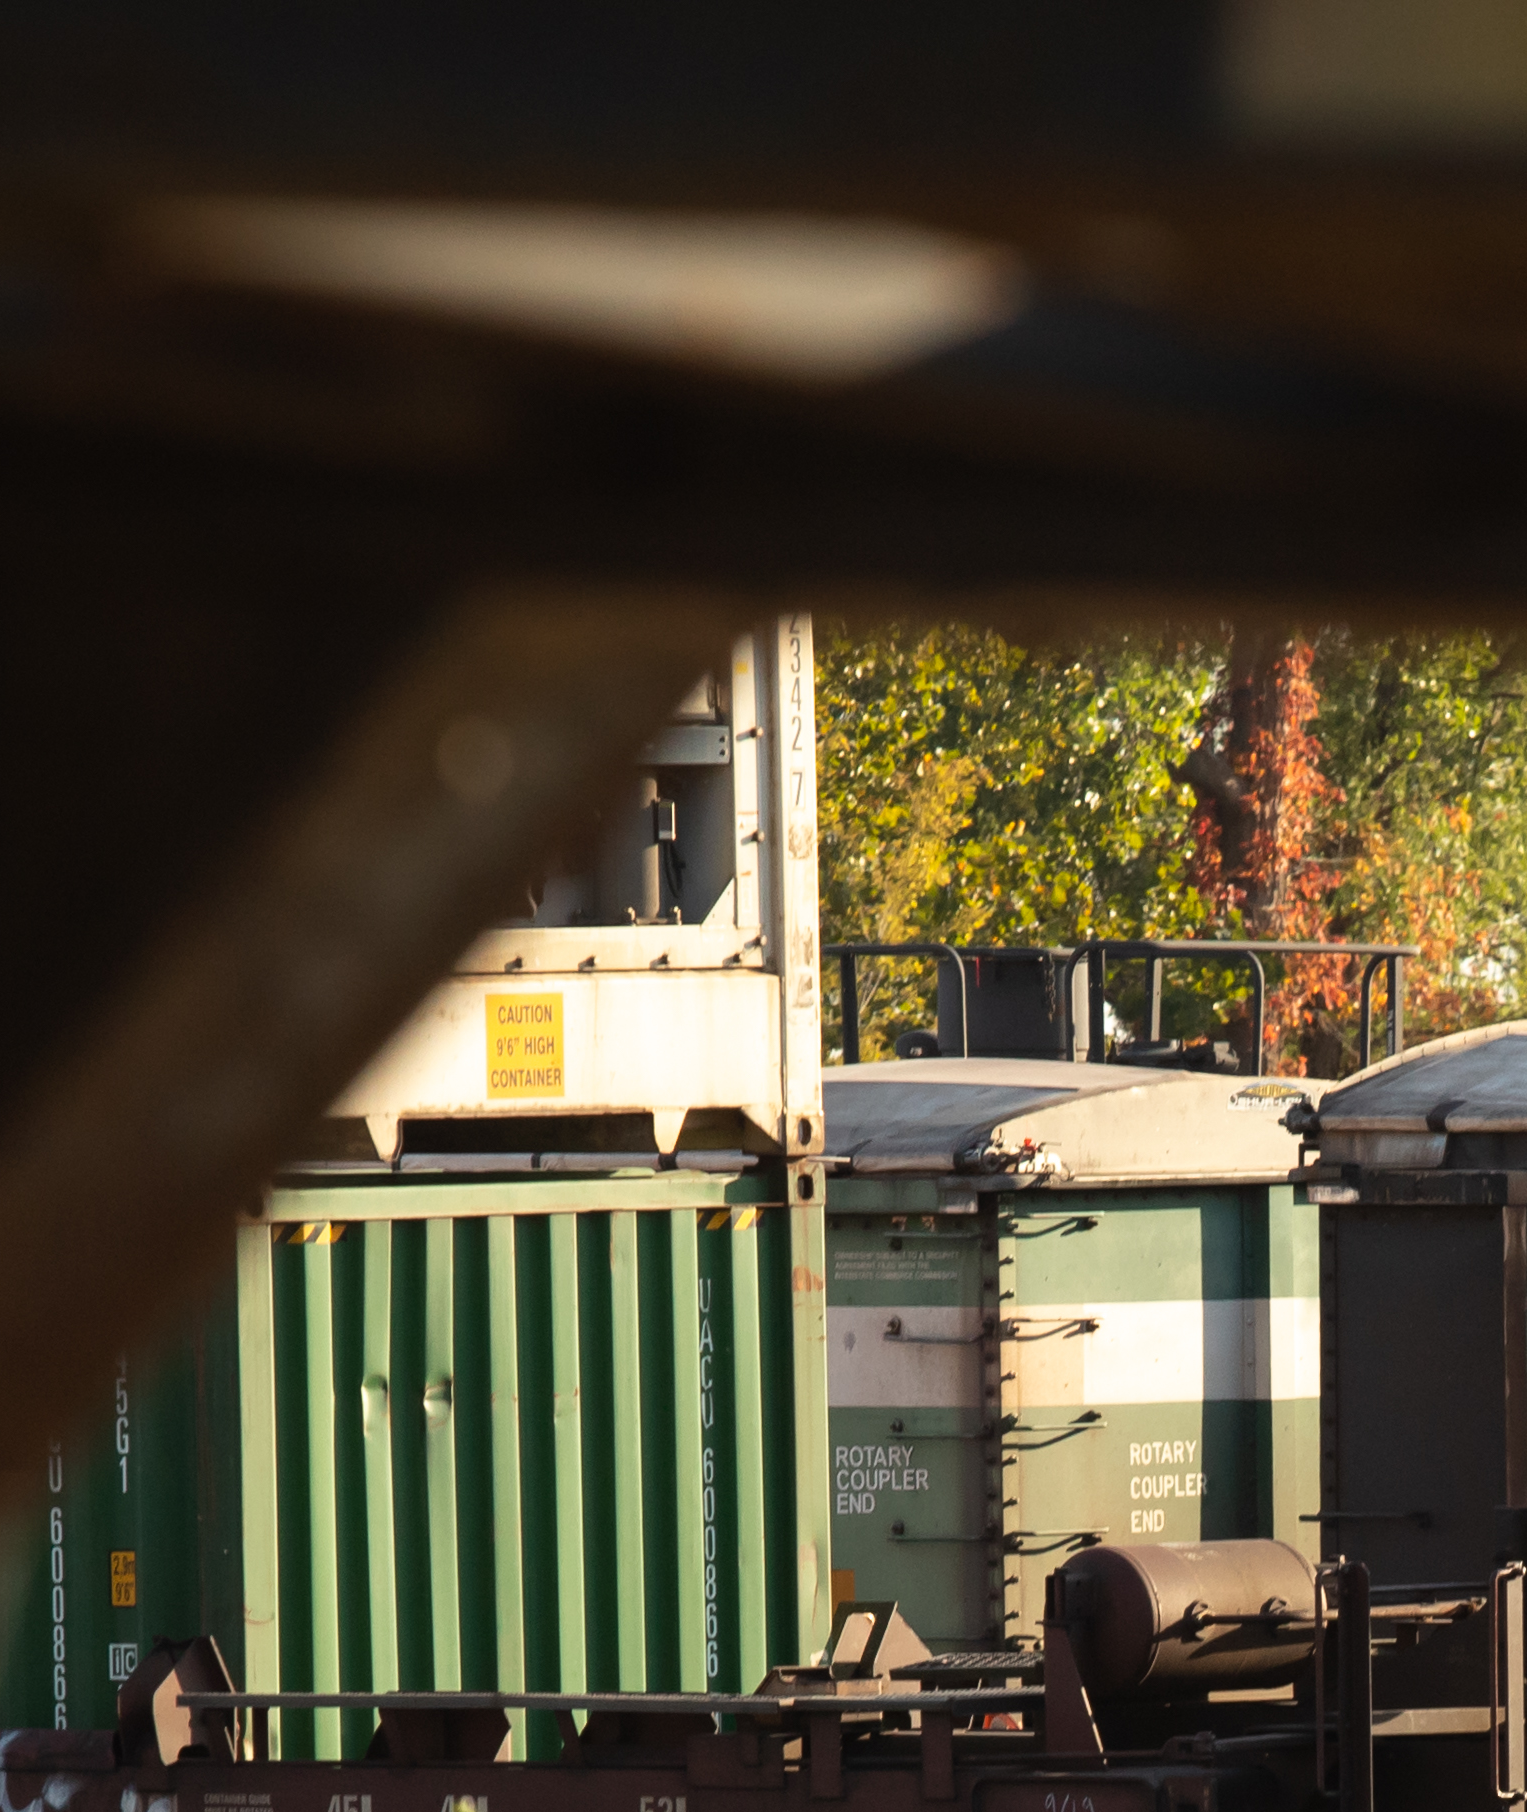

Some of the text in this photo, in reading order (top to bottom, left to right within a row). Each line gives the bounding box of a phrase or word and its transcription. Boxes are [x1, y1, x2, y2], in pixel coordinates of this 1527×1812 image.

[792, 771, 803, 806] 7
[497, 1004, 553, 1024] CAUTION
[524, 1036, 554, 1056] HIGH
[491, 1068, 562, 1088] CONTAINER
[835, 1445, 914, 1468] ROTARY
[1129, 1440, 1197, 1466] ROTARY
[699, 1278, 718, 1678] UACU 600866
[836, 1468, 930, 1491] COUPLER
[1130, 1472, 1208, 1499] COUPLER
[836, 1492, 876, 1515] END
[1131, 1509, 1165, 1534] END
